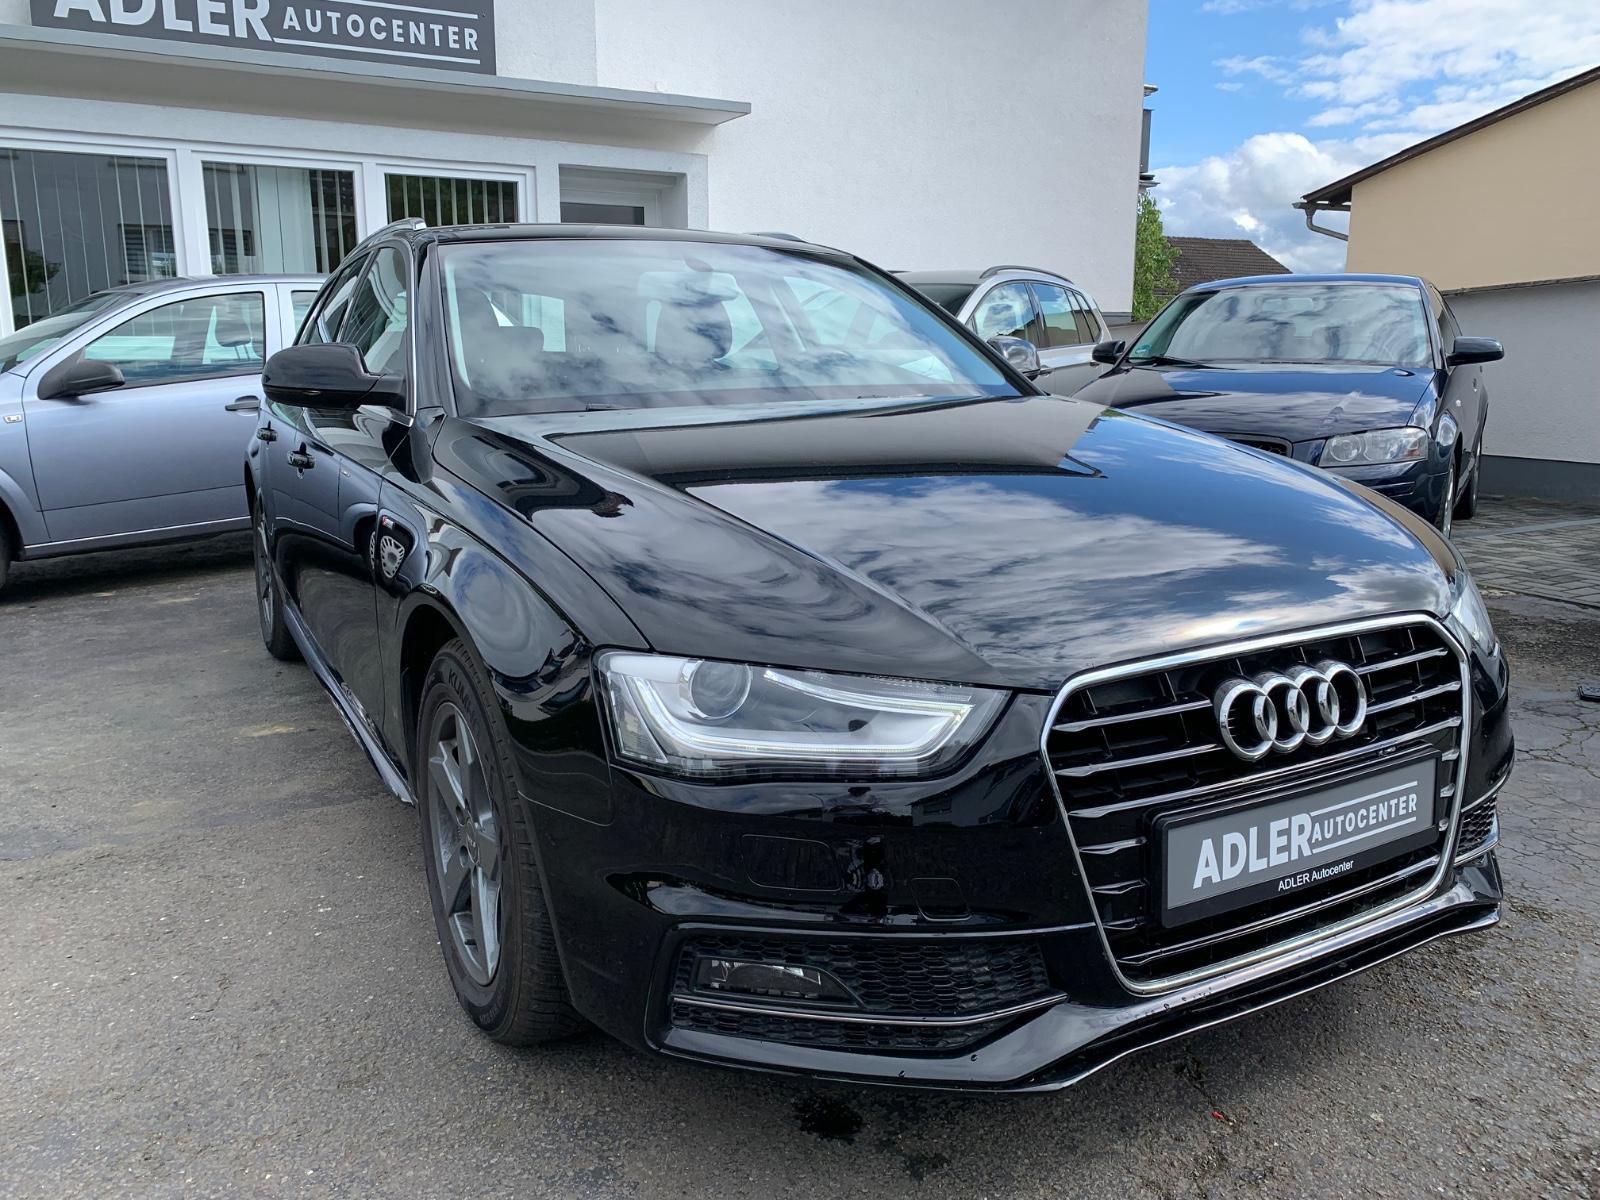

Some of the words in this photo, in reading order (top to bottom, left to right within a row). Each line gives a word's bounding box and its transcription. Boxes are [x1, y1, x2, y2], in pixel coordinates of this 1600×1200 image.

[283, 7, 479, 50] AUTOCENTER
[1193, 813, 1313, 889] ADLER
[1312, 793, 1417, 843] AUTOCENTER
[1278, 873, 1311, 892] ADLER
[1311, 860, 1354, 882] Autocenter
